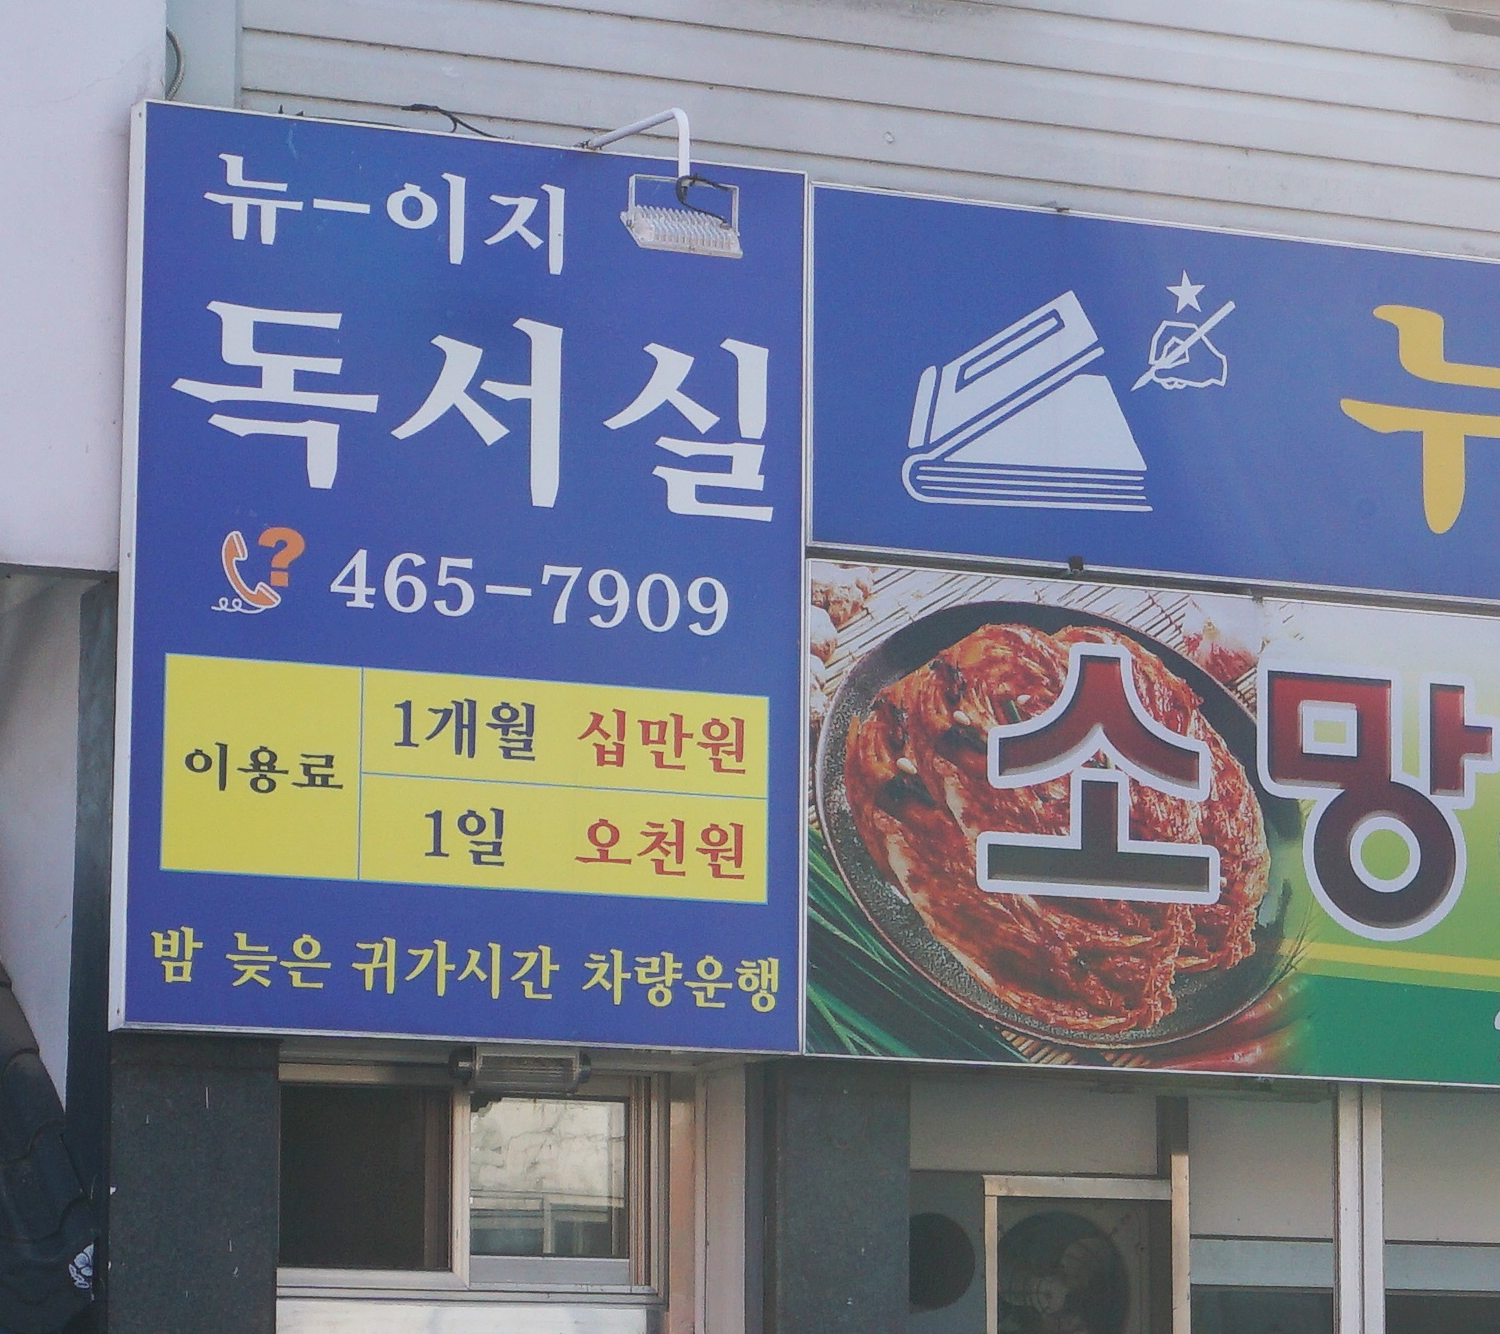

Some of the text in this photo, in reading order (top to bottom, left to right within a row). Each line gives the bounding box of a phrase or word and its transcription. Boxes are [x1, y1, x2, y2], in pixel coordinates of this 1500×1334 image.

[203, 153, 565, 275] 뉴-이지
[171, 299, 774, 523] 독서실
[329, 548, 731, 637] 465-7909
[183, 741, 344, 795] 이용료
[392, 699, 748, 776] 1개월 십만원
[422, 807, 747, 881] 1일 오천원
[150, 925, 780, 1014] 밤 늦은 귀가시간 차량운행
